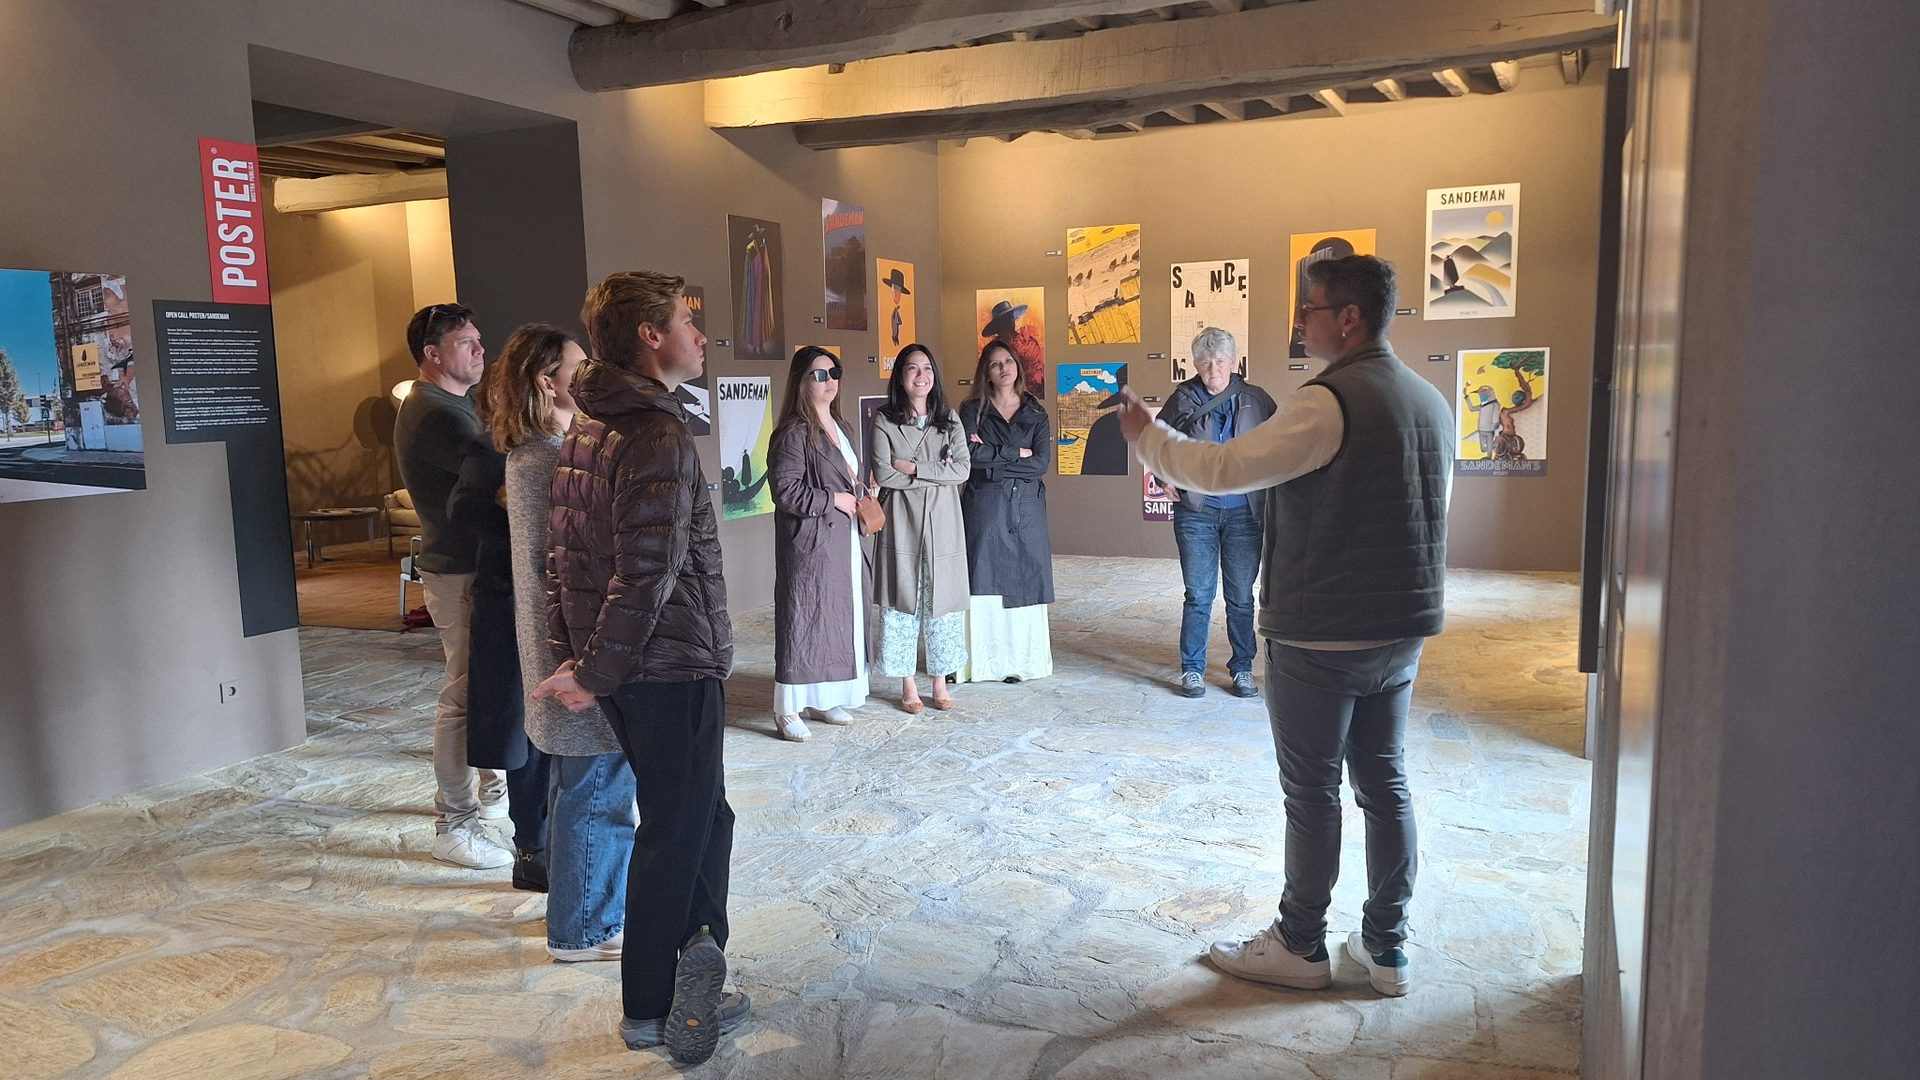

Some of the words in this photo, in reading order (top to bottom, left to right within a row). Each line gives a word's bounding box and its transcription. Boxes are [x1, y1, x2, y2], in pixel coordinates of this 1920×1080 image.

[1441, 189, 1505, 205] SANDEMAN
[212, 157, 257, 287] POSTER
[824, 211, 864, 233] SANDEMAN
[165, 311, 177, 319] OPEN
[178, 311, 188, 319] CALL
[719, 383, 770, 401] SANDEMAN
